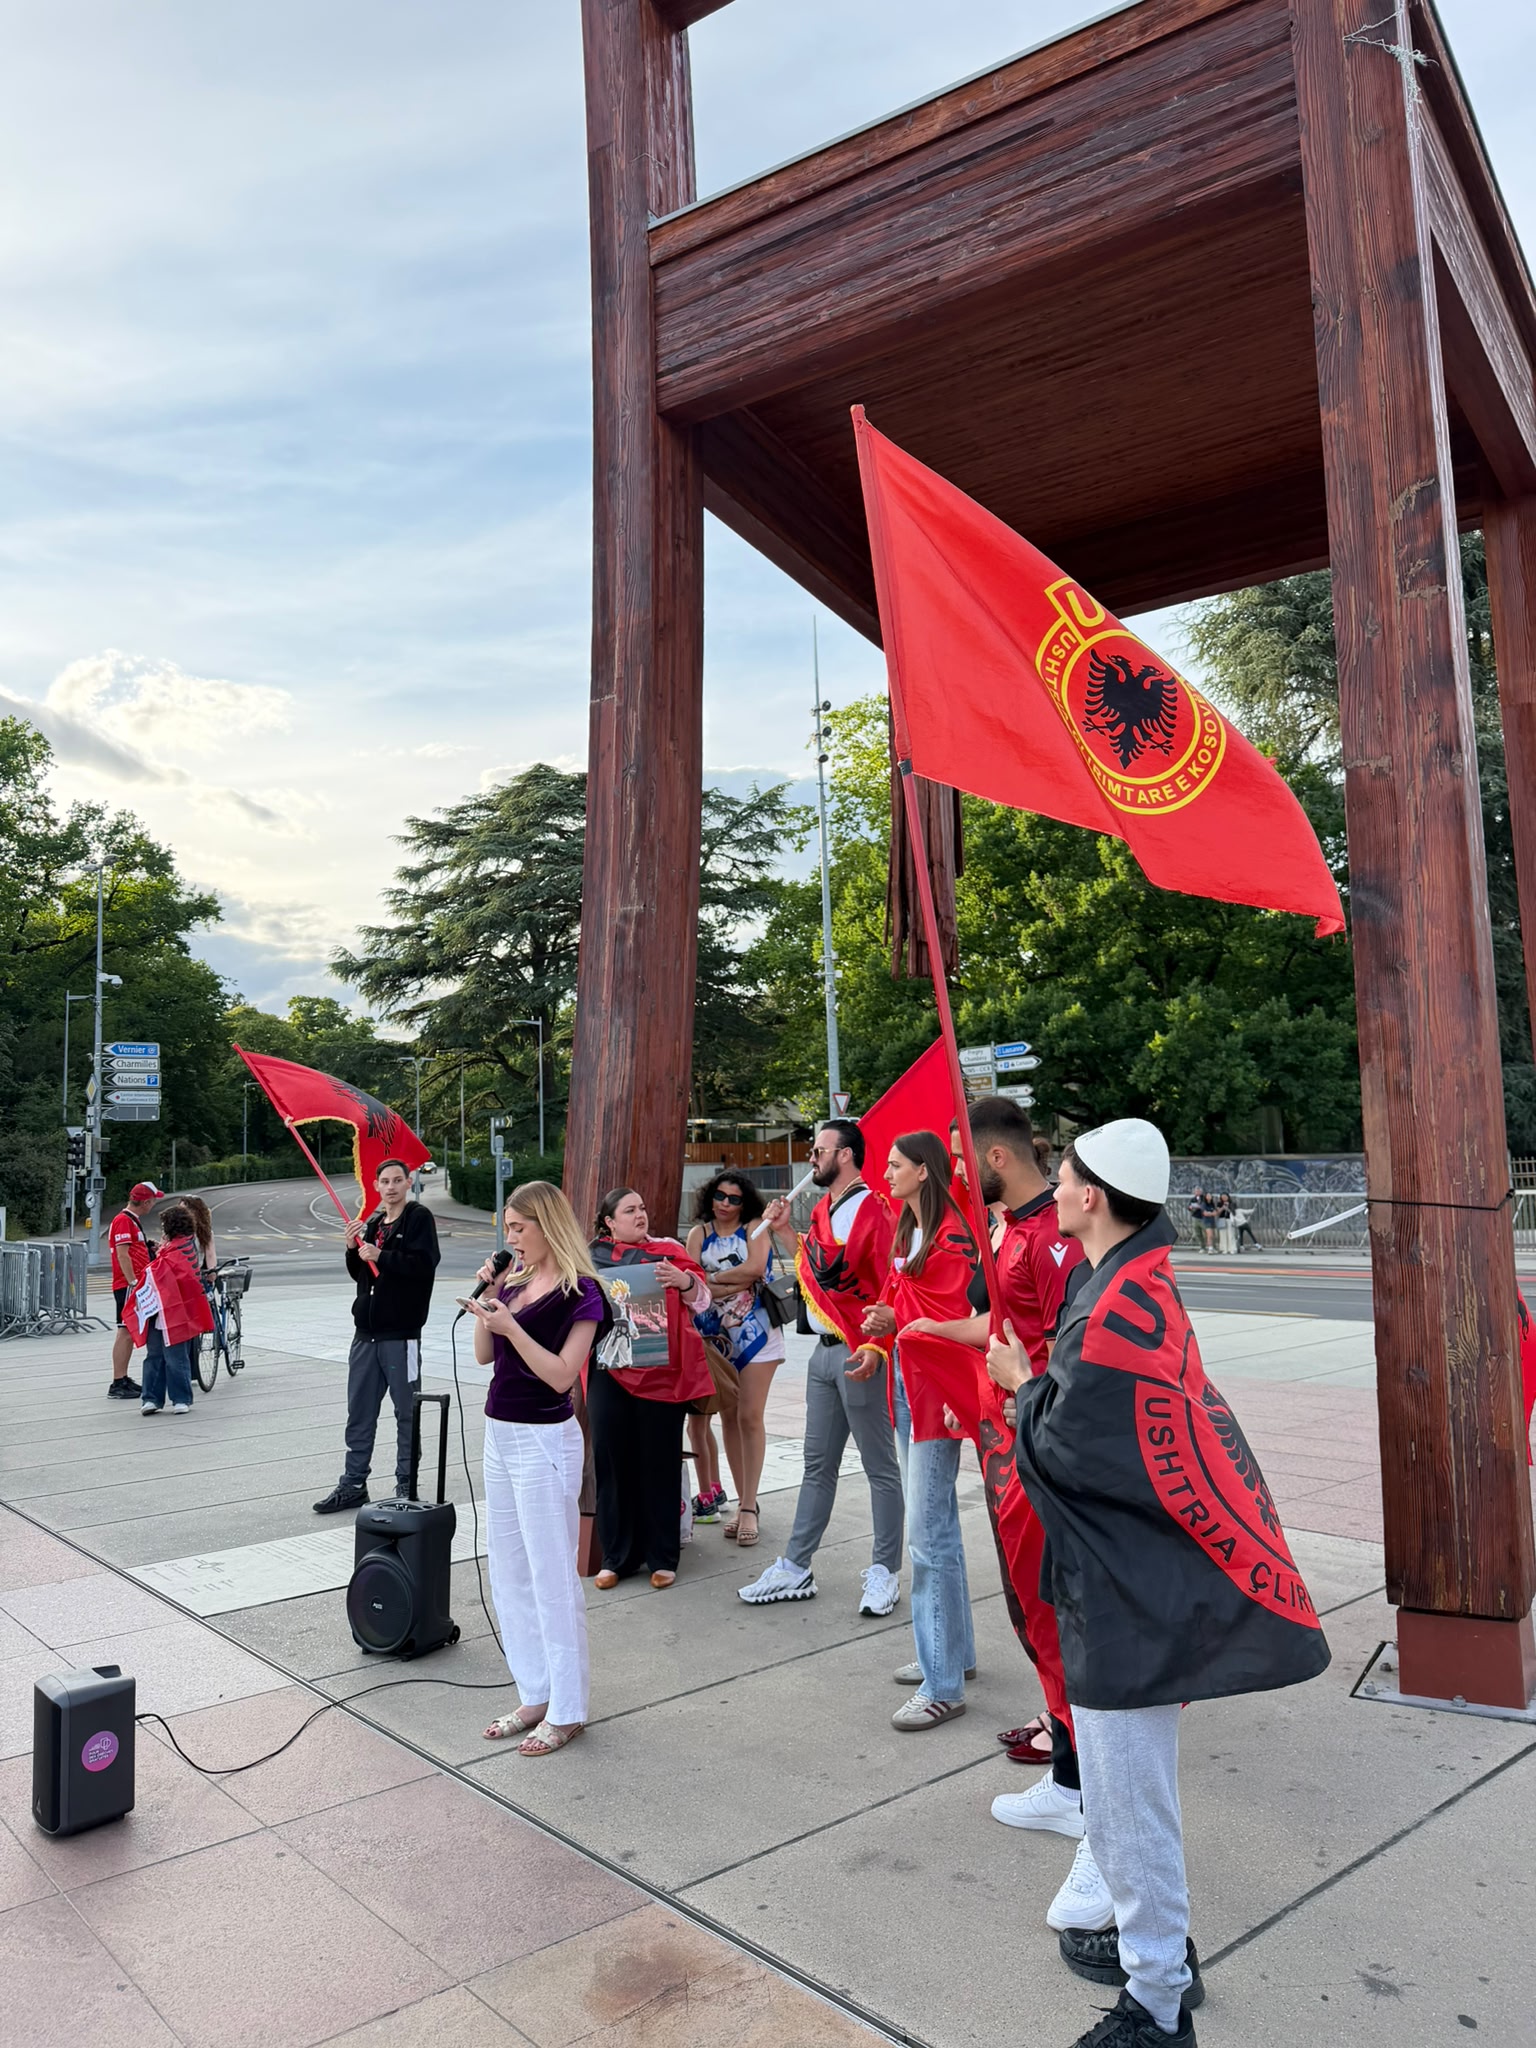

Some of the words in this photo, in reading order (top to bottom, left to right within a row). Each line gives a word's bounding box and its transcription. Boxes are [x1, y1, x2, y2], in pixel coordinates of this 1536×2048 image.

[1175, 774, 1191, 792] E
[117, 1045, 146, 1054] Vernier
[116, 1060, 157, 1068] Charmilles
[117, 1076, 146, 1084] Nations
[1144, 1396, 1236, 1564] USHTRIA
